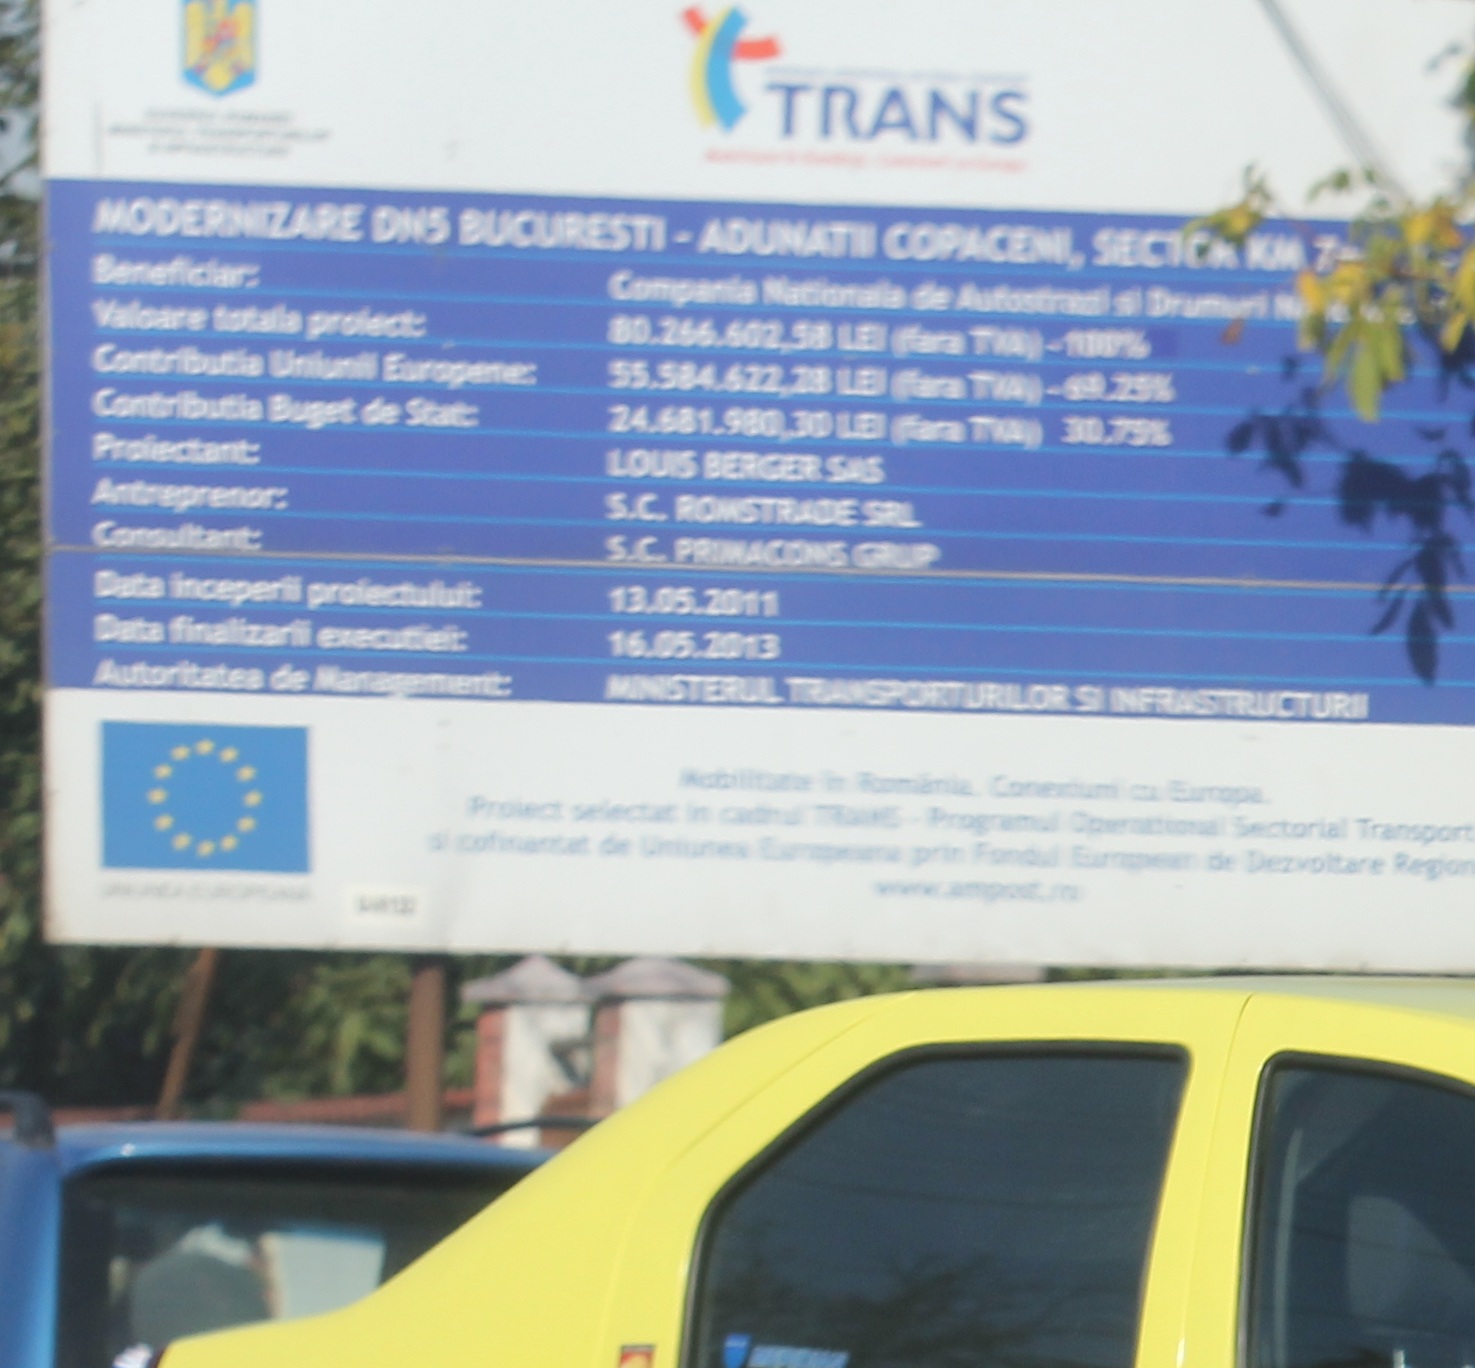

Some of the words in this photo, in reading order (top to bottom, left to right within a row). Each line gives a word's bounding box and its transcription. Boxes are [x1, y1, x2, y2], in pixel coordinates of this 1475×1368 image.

[765, 83, 1029, 145] TRANS
[94, 197, 363, 241] MODERNIZARE
[372, 207, 450, 243] DN5
[459, 209, 666, 250] BUCURESTI
[697, 218, 877, 258] ADUNATII
[883, 223, 1085, 271] COPACENI,
[1245, 234, 1306, 271] KM
[92, 253, 260, 289] Beneficiar:
[608, 270, 757, 308] Compania
[761, 275, 906, 308] Nationala
[911, 280, 952, 310] de
[957, 282, 1111, 316] Autostrazi
[1113, 286, 1142, 316] si
[1146, 287, 1270, 319] Drumuri
[92, 299, 208, 332] Valoare
[213, 304, 301, 333] totala
[306, 308, 427, 339] proiect:
[837, 323, 888, 352] LEI
[891, 325, 966, 358] (fara
[969, 326, 1043, 363] TVA)
[92, 343, 264, 377] Contributia
[268, 349, 378, 380] Uniunii
[383, 353, 537, 389] Europene:
[837, 367, 888, 396] LEI
[891, 369, 966, 402] (fara
[968, 370, 1043, 407] TVA)
[92, 388, 264, 421] Contributia
[268, 394, 357, 429] Buget
[360, 398, 398, 425] de
[405, 398, 478, 427] Stat:
[92, 433, 260, 464] Proiectant:
[836, 412, 886, 440] LEI
[890, 414, 966, 446] (fara
[968, 415, 1043, 449] TVA)
[606, 449, 698, 479] LOUIS
[703, 452, 823, 481] BERGER
[825, 456, 885, 483] SAS
[92, 478, 288, 513] Antreprenor:
[605, 492, 667, 521] S.C.
[675, 496, 859, 527] ROMSTRADE
[861, 501, 923, 527] SRL
[92, 521, 263, 551] Consultant:
[605, 535, 667, 562] S.C.
[851, 542, 942, 569] GRUP
[95, 570, 164, 600] Data
[169, 572, 302, 607] inceperii
[307, 578, 482, 610] proiectului:
[607, 586, 778, 617] 13.05.2011
[95, 614, 164, 643] Data
[169, 615, 311, 647] finalizarii
[607, 630, 780, 660] 16.05.2013
[94, 659, 264, 690] Autoritatea
[269, 664, 310, 691] de
[312, 665, 512, 697] Management:
[604, 674, 785, 702] MINISTERUL
[785, 678, 1069, 711] TRANSPORTURILOR
[1075, 686, 1102, 712] SI
[1111, 687, 1368, 719] INFRASTRUCTURII
[679, 768, 812, 792] Mobilitate
[466, 795, 562, 821] Proiect
[573, 799, 677, 823] selectat
[929, 806, 1058, 834] Programul
[1234, 815, 1348, 839] Sectorial
[600, 834, 630, 856] de
[639, 836, 748, 860] Uniunea
[912, 842, 965, 867] prin
[1246, 850, 1386, 876] Dezvoltare
